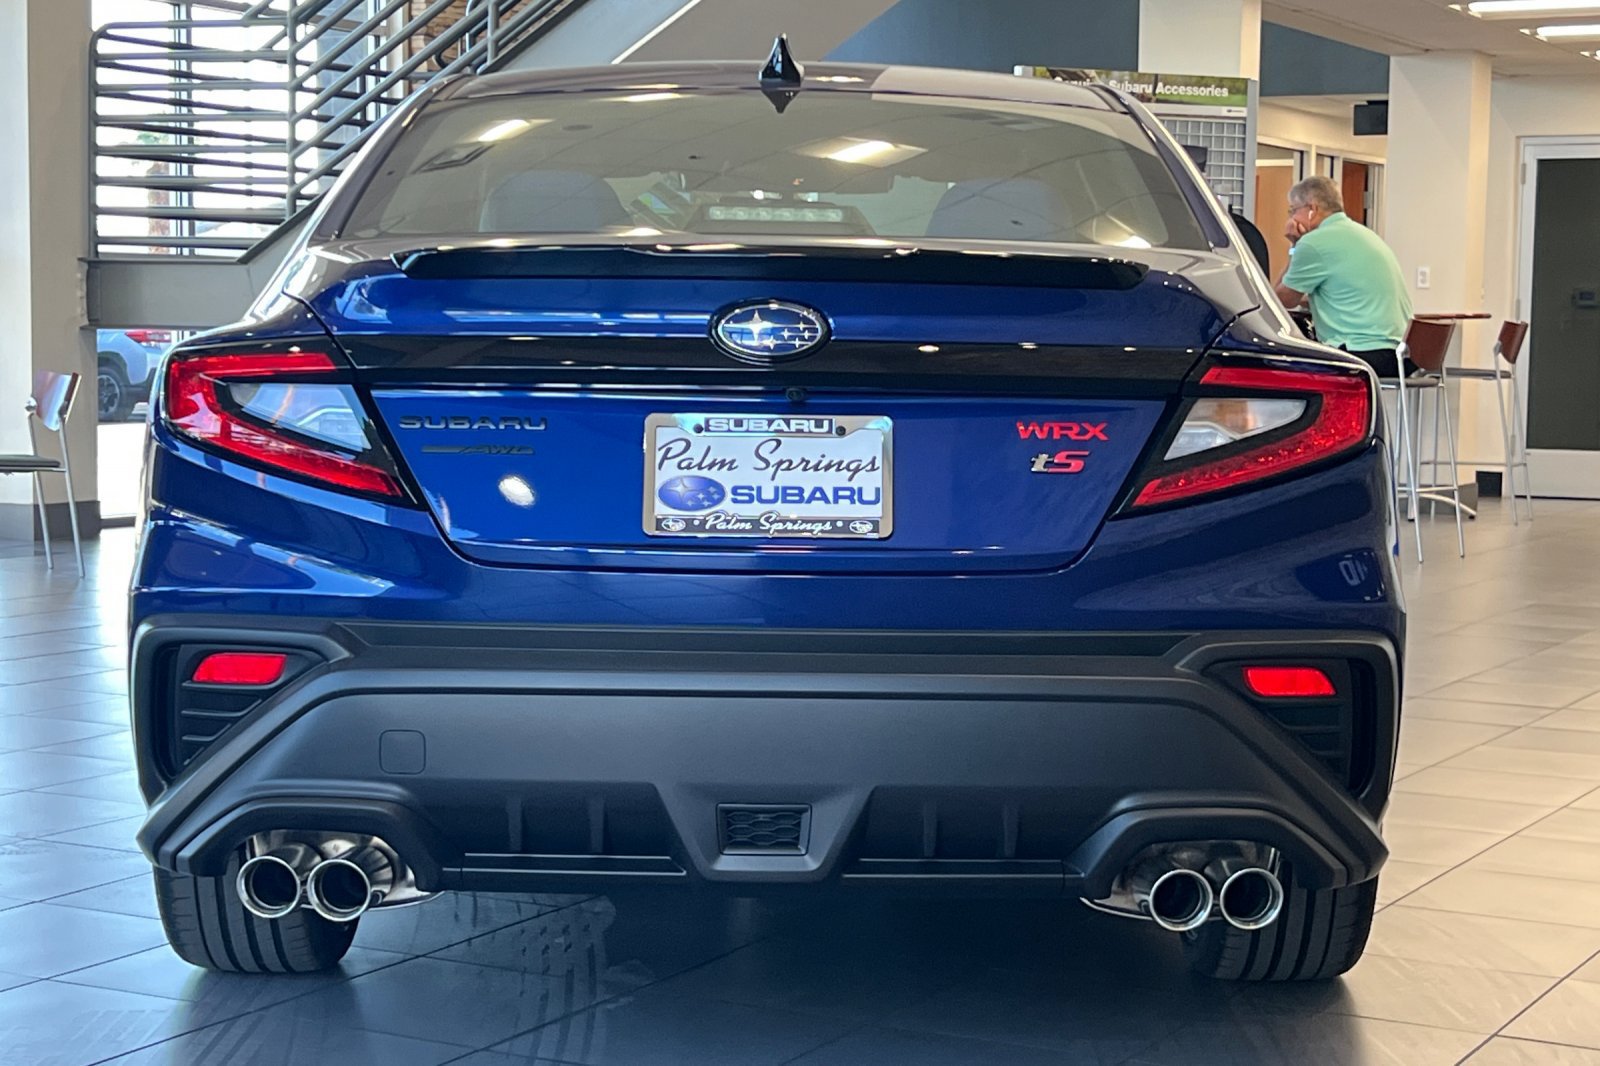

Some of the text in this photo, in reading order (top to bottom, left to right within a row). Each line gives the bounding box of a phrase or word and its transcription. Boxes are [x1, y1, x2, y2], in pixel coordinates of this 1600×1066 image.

[1155, 82, 1229, 98] Accessories
[398, 415, 547, 430] SUBARU
[708, 418, 829, 433] SUBARU
[1016, 421, 1108, 441] WRX
[658, 438, 881, 482] Palm Springs
[1031, 450, 1089, 473] tS
[730, 485, 881, 505] SUBARU
[704, 512, 833, 534] Palm Springs
